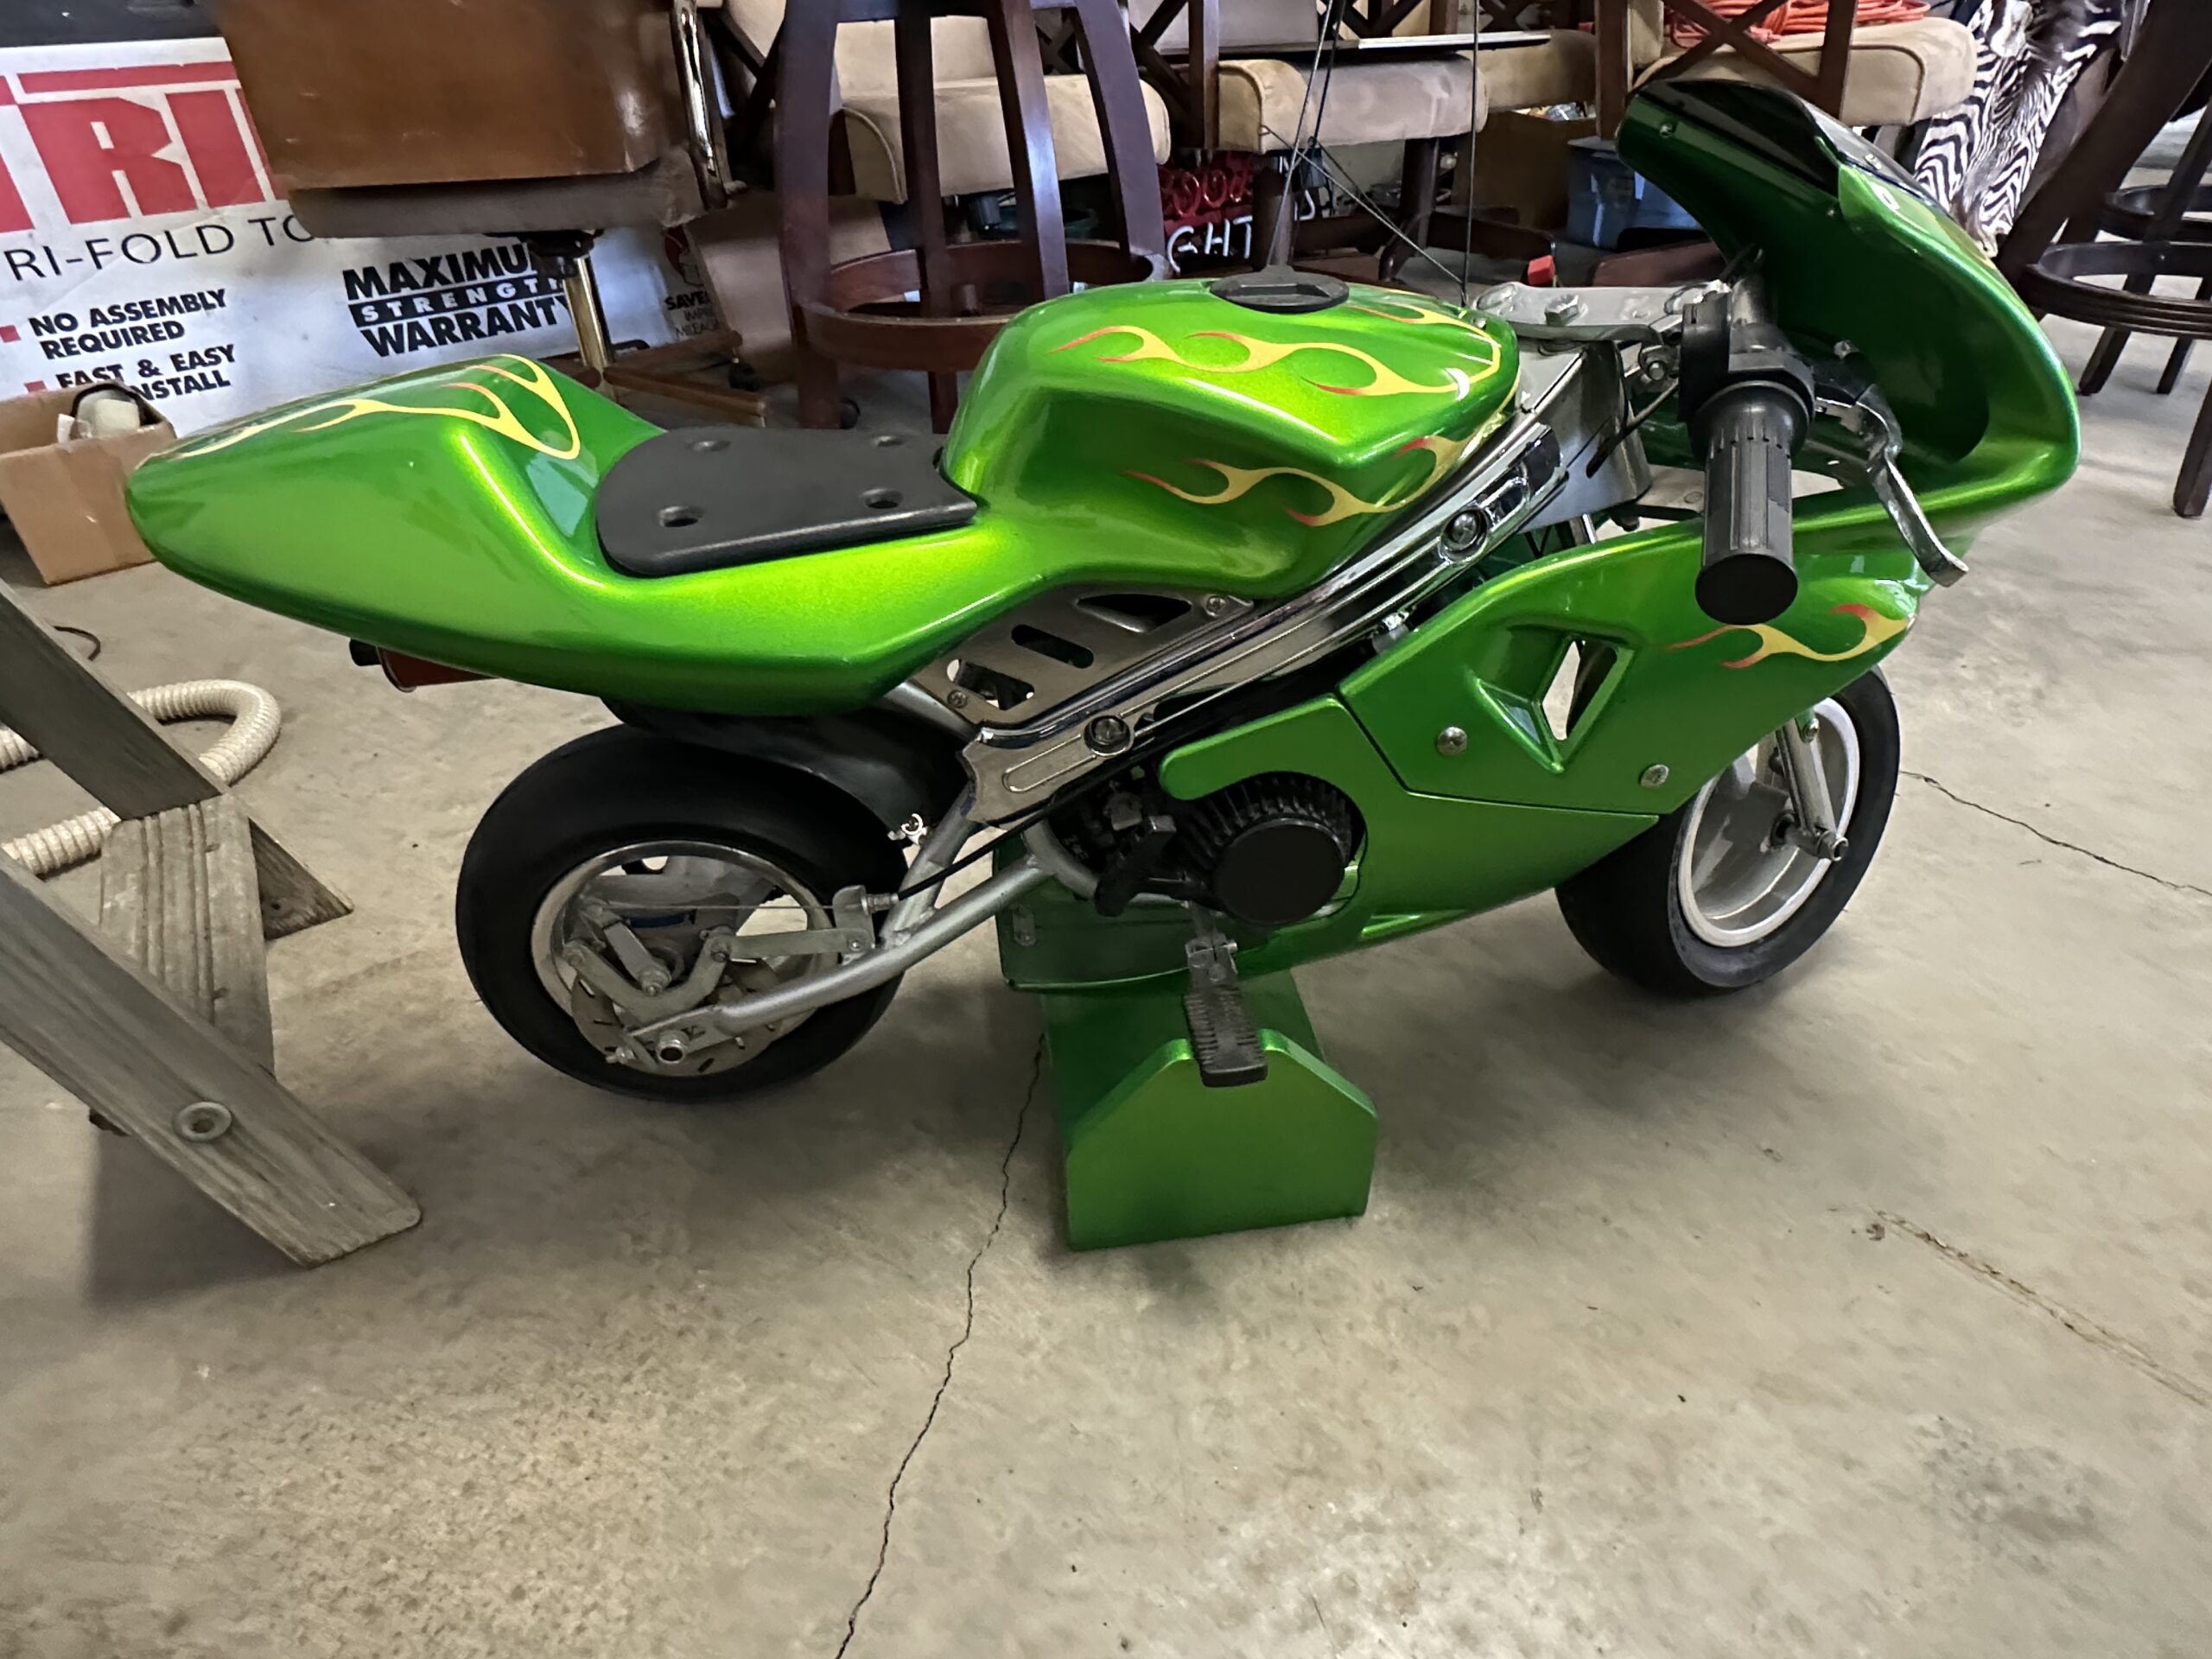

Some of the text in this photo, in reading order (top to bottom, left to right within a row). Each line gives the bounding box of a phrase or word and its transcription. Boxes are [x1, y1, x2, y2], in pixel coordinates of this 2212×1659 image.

[342, 243, 537, 301] MAXIMU
[29, 289, 227, 339] NO ASSEMBLY
[38, 321, 186, 360] REQUIRED
[56, 344, 236, 389] FAST & EASY
